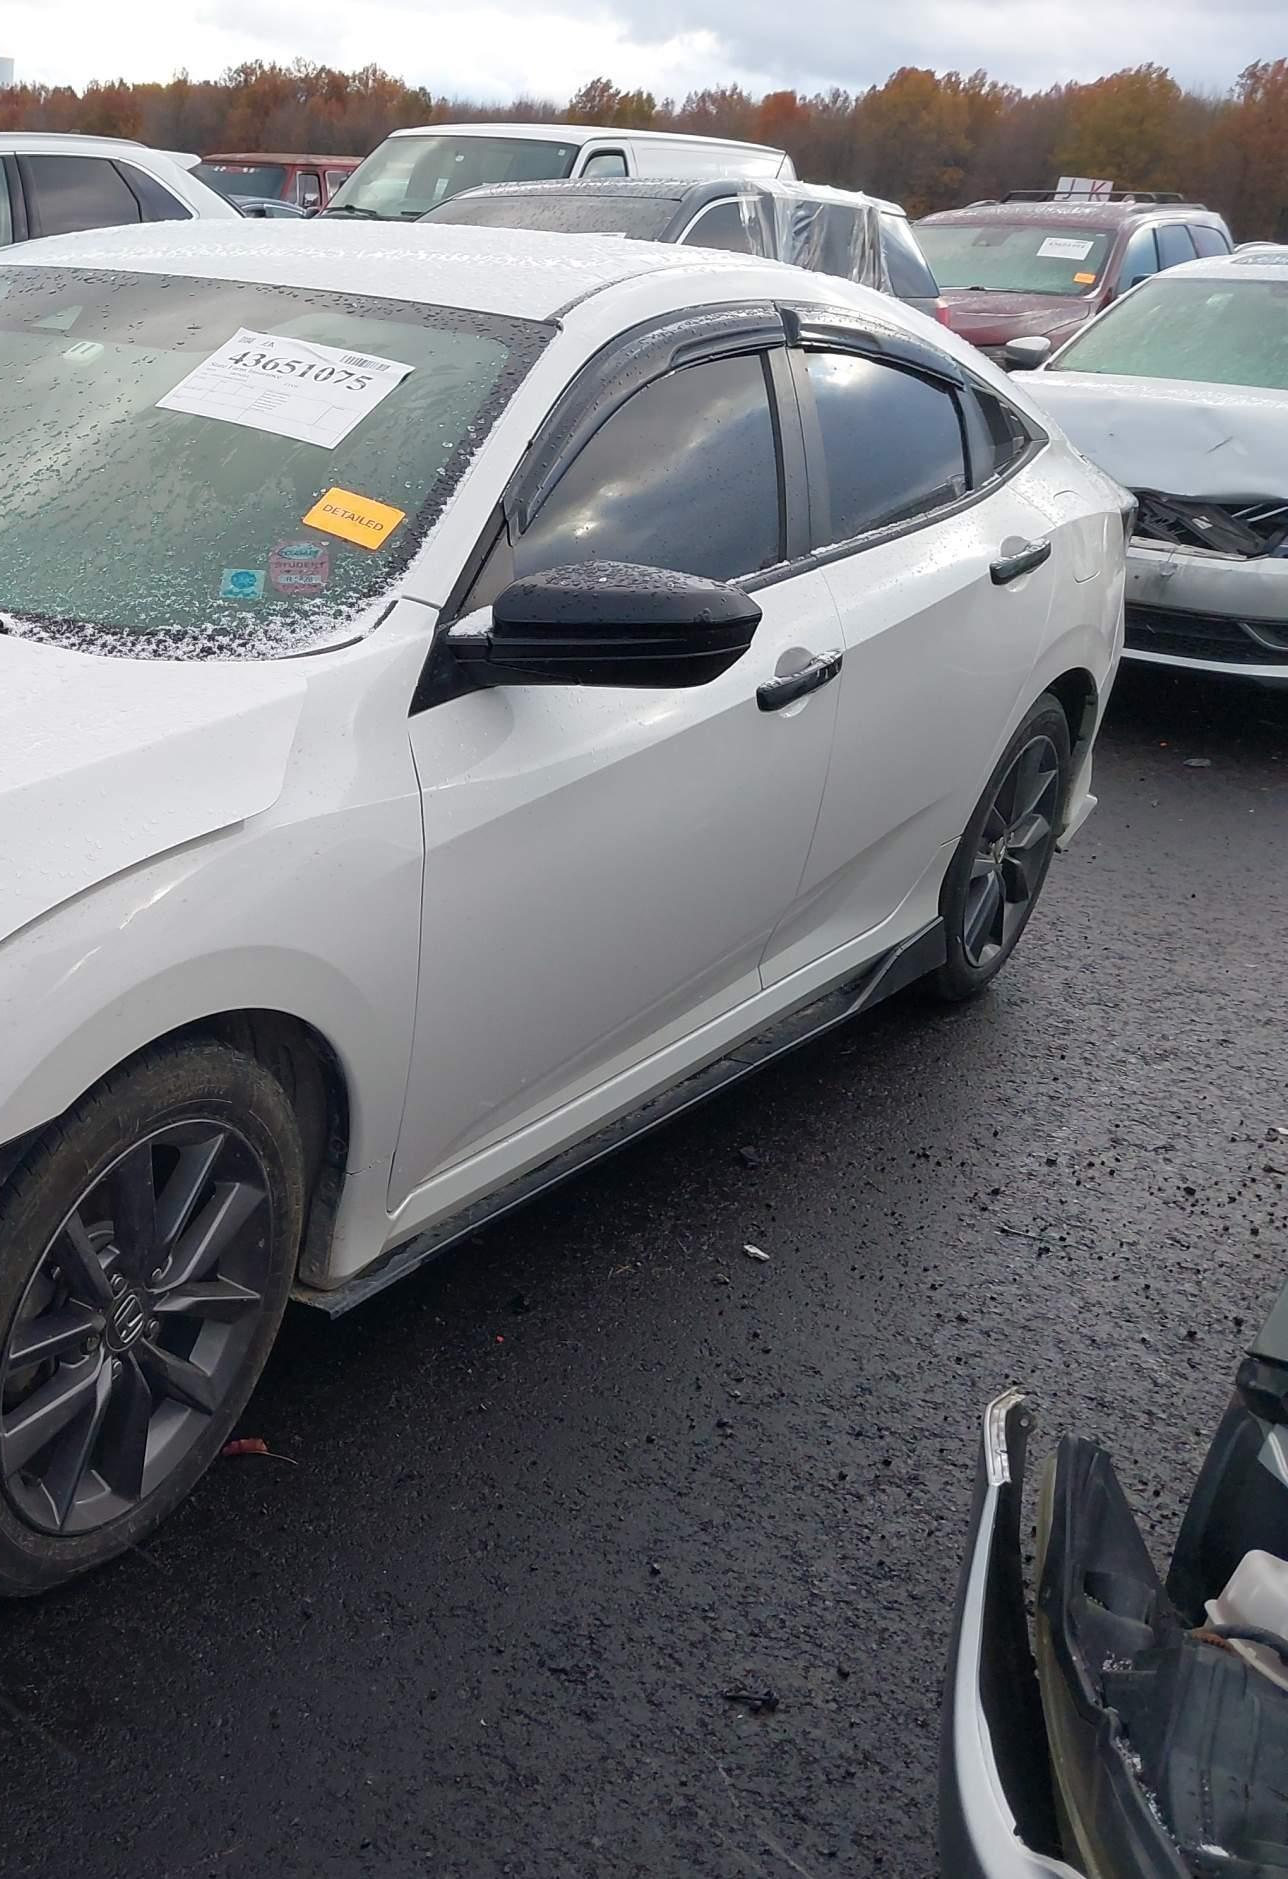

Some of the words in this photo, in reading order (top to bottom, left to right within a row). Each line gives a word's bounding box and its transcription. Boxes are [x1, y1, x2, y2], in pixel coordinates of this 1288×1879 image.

[1063, 178, 1076, 200] J
[1088, 180, 1107, 202] K
[228, 351, 373, 391] 43651075
[323, 503, 385, 531] DETAILED
